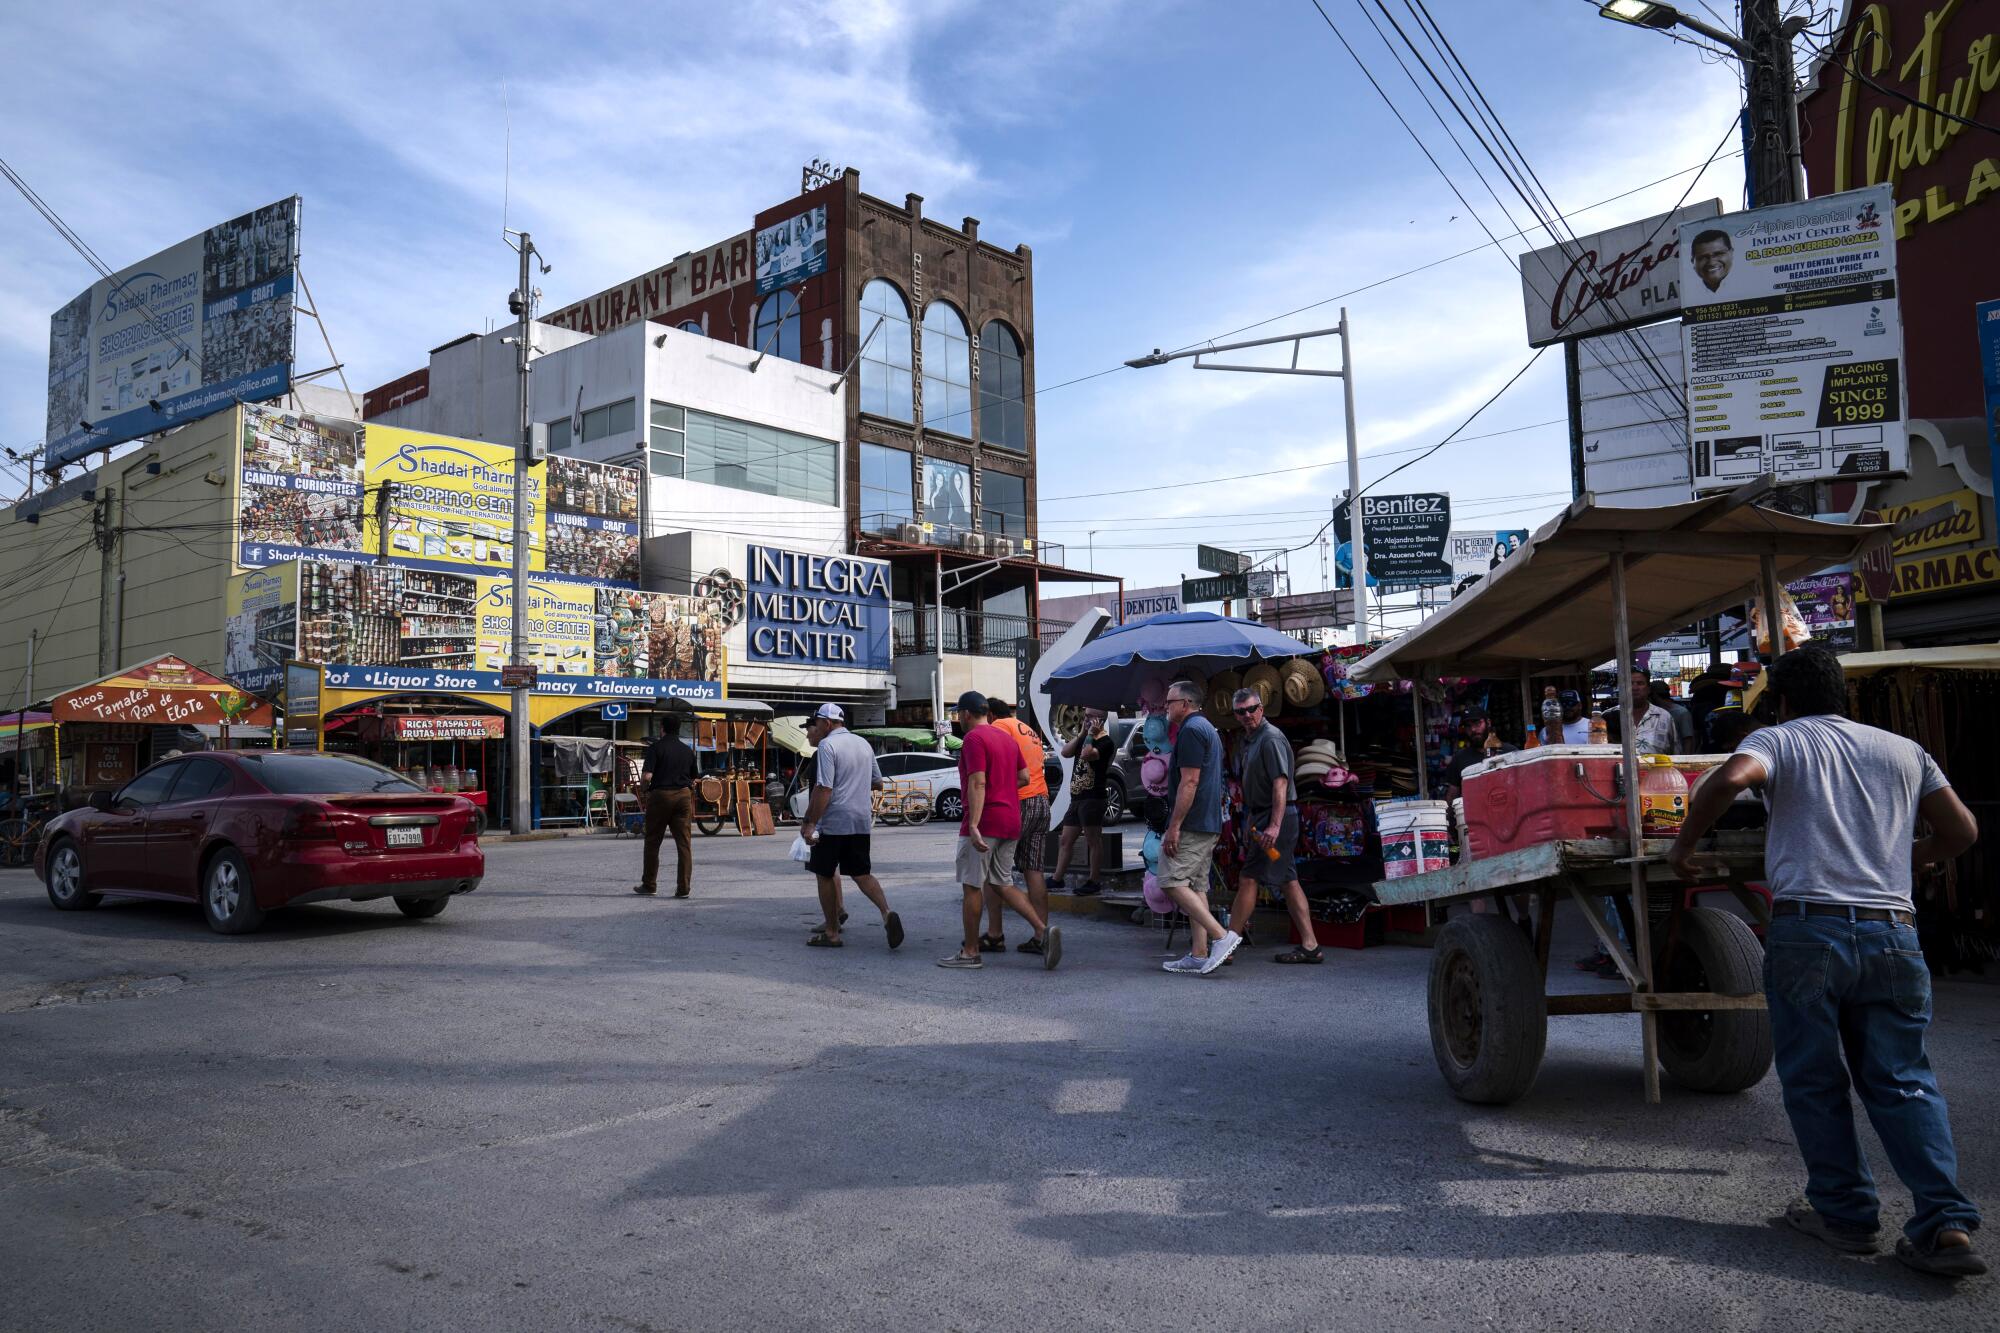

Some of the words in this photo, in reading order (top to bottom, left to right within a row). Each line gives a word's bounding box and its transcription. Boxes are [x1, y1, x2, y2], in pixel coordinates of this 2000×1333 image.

[1795, 208, 1852, 227] Dental
[1752, 232, 1802, 247] IMPLANT
[1806, 224, 1850, 238] CENTER
[1746, 249, 1760, 260] DR.
[1762, 244, 1792, 258] EDGAR
[1793, 237, 1841, 253] GUERRERO
[691, 238, 748, 297] BAR
[1773, 262, 1805, 273] QUALITY
[1807, 259, 1834, 269] DENTAL
[1835, 254, 1861, 264] WORK
[1789, 266, 1838, 280] REASONABLE
[1839, 263, 1863, 273] PRICE
[105, 286, 148, 322] Shaddai
[151, 271, 199, 302] Pharmacy
[251, 283, 275, 303] CRAFT
[1640, 281, 1679, 306] PLA
[208, 296, 238, 319] LIQUORS
[99, 319, 152, 356] SHOPPING
[151, 303, 195, 336] CENTER
[912, 252, 924, 424] RESTAURANT
[972, 334, 980, 381] BAR
[1691, 376, 1717, 384] MORE
[1717, 369, 1773, 382] TREATMENTS
[1834, 362, 1884, 375] PLACING
[1830, 373, 1888, 387] IMPLANTS
[1829, 387, 1887, 405] SINCE
[1832, 403, 1884, 423] 1999
[398, 444, 468, 478] Shaddai
[472, 466, 540, 489] Pharmcy
[244, 470, 287, 488] CANDYS
[294, 477, 357, 497] CURIOSITIES
[473, 482, 487, 491] God
[488, 484, 514, 496] almigh
[915, 440, 925, 526] MEDICA
[973, 456, 982, 534] CENTE
[475, 495, 535, 517] CENTR
[554, 512, 588, 527] LIQUORS
[602, 519, 627, 533] CRAFT
[1364, 516, 1403, 526] Dental
[1409, 515, 1445, 523] Clinic
[1383, 536, 1414, 545] Alejandro
[1471, 538, 1493, 546] DENTAL
[1471, 546, 1492, 554] CLINIC
[754, 545, 890, 598] INTEGRA
[1194, 580, 1237, 598] COAHUILA
[544, 598, 594, 615] Pharmacy
[754, 592, 868, 629] MEDICAL
[1126, 596, 1178, 616] DENTISTA
[546, 619, 590, 635] CENTER
[754, 626, 856, 661] CENTER
[246, 672, 263, 688] best
[263, 667, 285, 685] price
[373, 672, 431, 689] Liquor
[434, 673, 478, 689] Store
[594, 680, 655, 696] Talavera
[667, 684, 715, 699] Candys
[1018, 648, 1026, 708] NUEVO
[68, 691, 105, 711] Ricos
[93, 688, 150, 719] Tamales
[130, 703, 156, 721] Pan
[159, 693, 173, 707] de
[402, 729, 435, 738] FRUTAS
[437, 728, 487, 737] NATURALES
[406, 719, 433, 729] RICAS
[436, 719, 469, 728] RASPAS
[471, 719, 483, 727] DE
